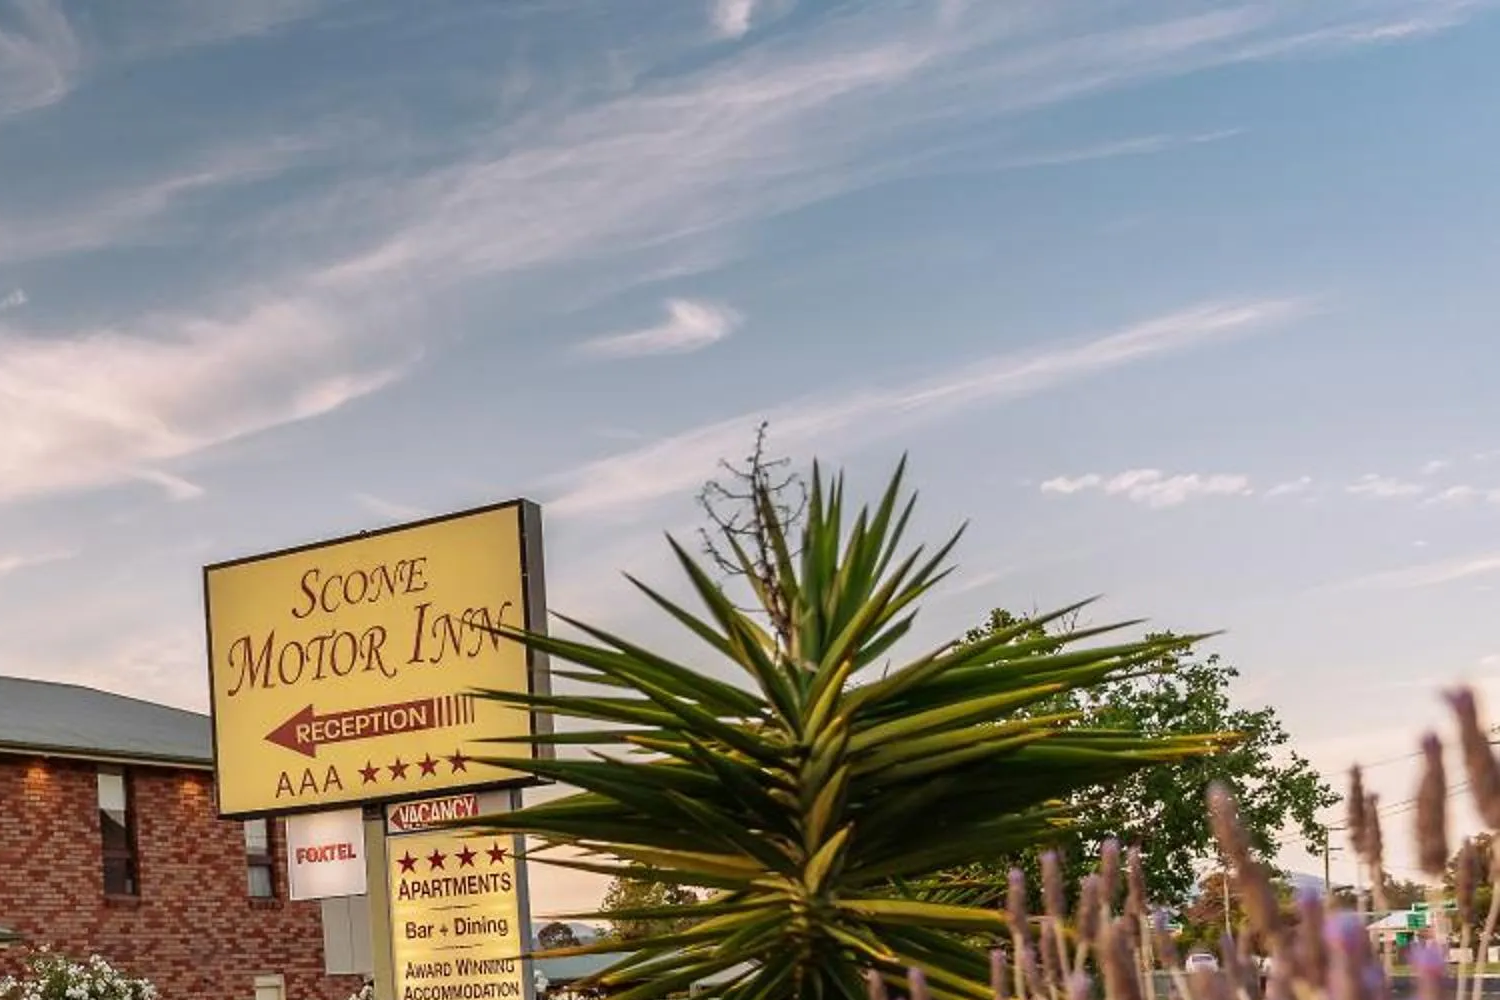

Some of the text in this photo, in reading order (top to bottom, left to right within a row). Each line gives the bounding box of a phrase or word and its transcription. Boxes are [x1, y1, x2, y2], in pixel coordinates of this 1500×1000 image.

[291, 556, 429, 619] SCONE
[227, 602, 513, 697] MOTOR INN
[296, 705, 427, 744] RECEPTION
[275, 764, 344, 799] AAA
[400, 795, 475, 823] VACANCY
[296, 843, 356, 864] FOXTEL
[398, 872, 512, 900] APARTMENTS
[405, 922, 435, 938] Bar
[454, 916, 509, 937] Dining
[405, 957, 515, 980] AWARD WINNING
